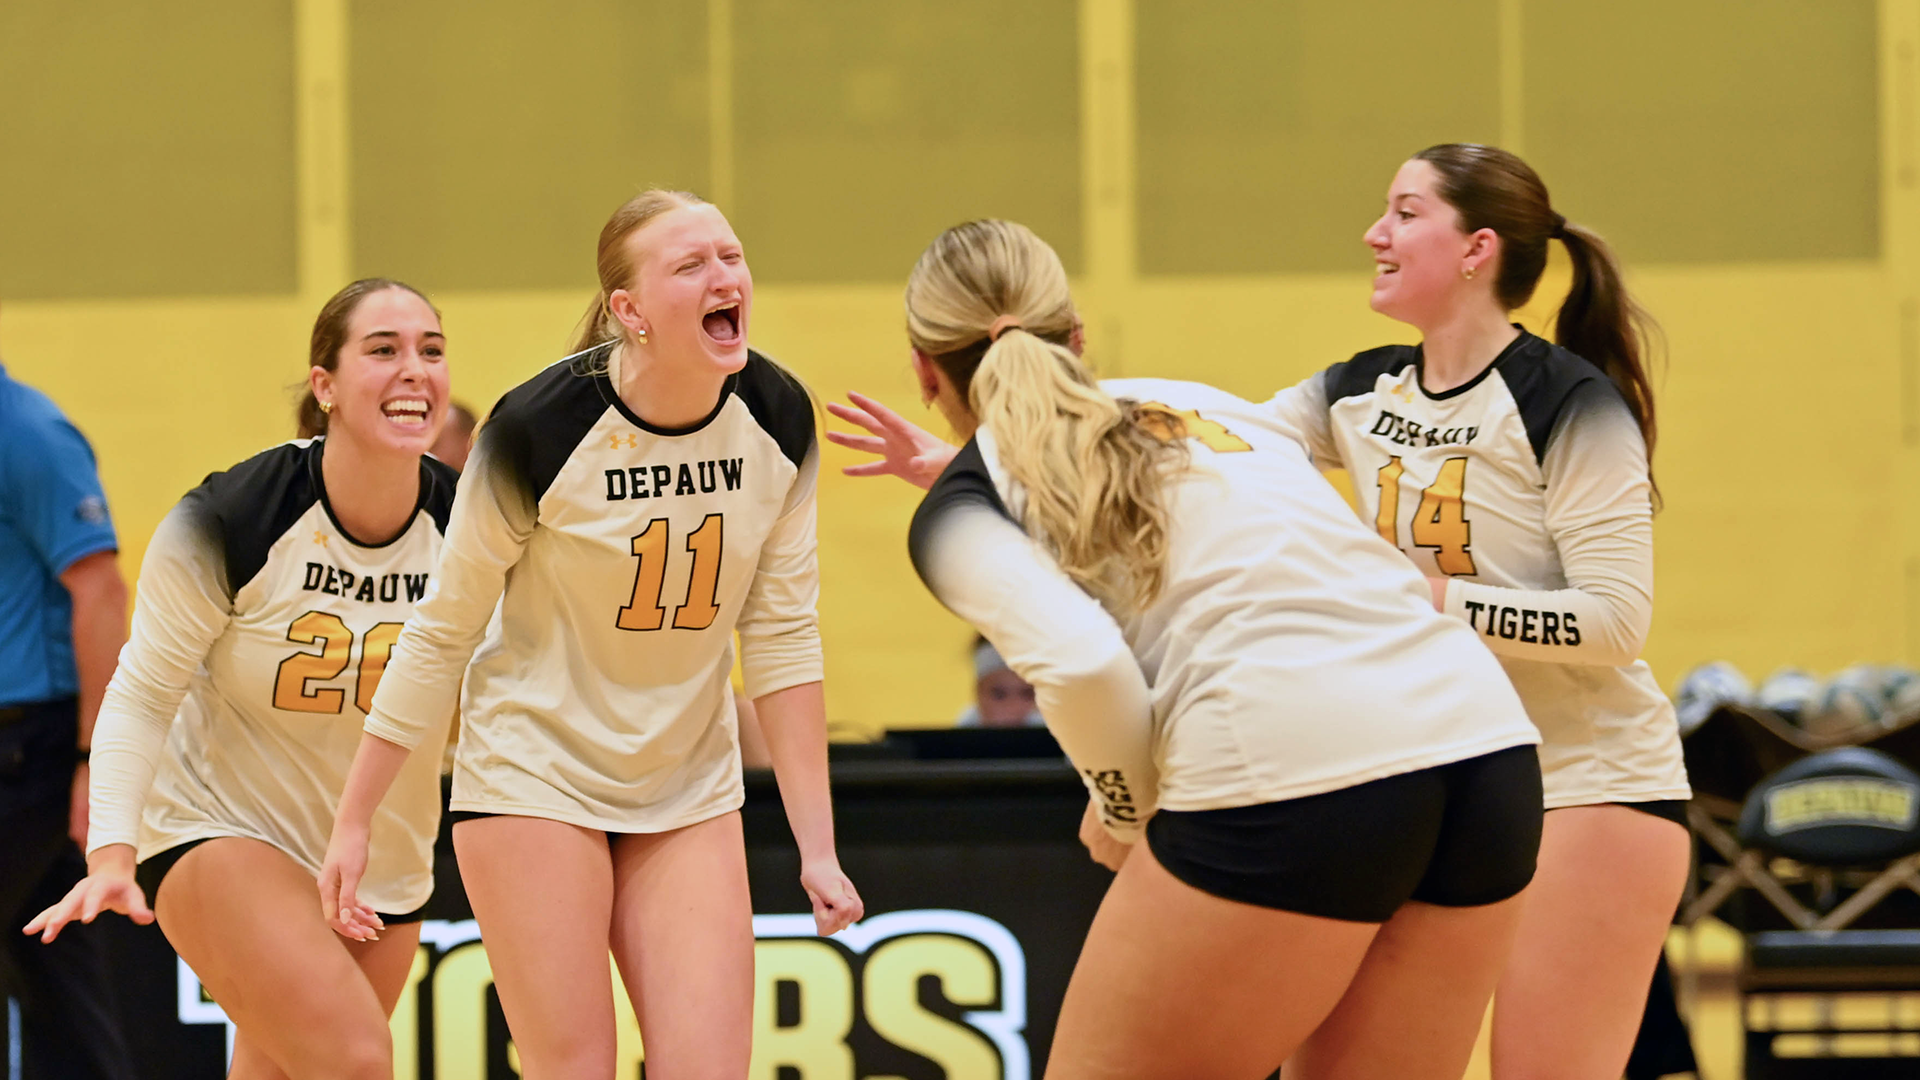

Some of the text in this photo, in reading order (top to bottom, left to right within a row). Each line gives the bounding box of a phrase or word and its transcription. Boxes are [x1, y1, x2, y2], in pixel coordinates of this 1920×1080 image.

[604, 457, 743, 501] DEPAUW
[1375, 455, 1478, 576] 14
[302, 561, 429, 603] DEPAUW
[615, 512, 723, 632] 11
[1465, 600, 1582, 647] TIGERS
